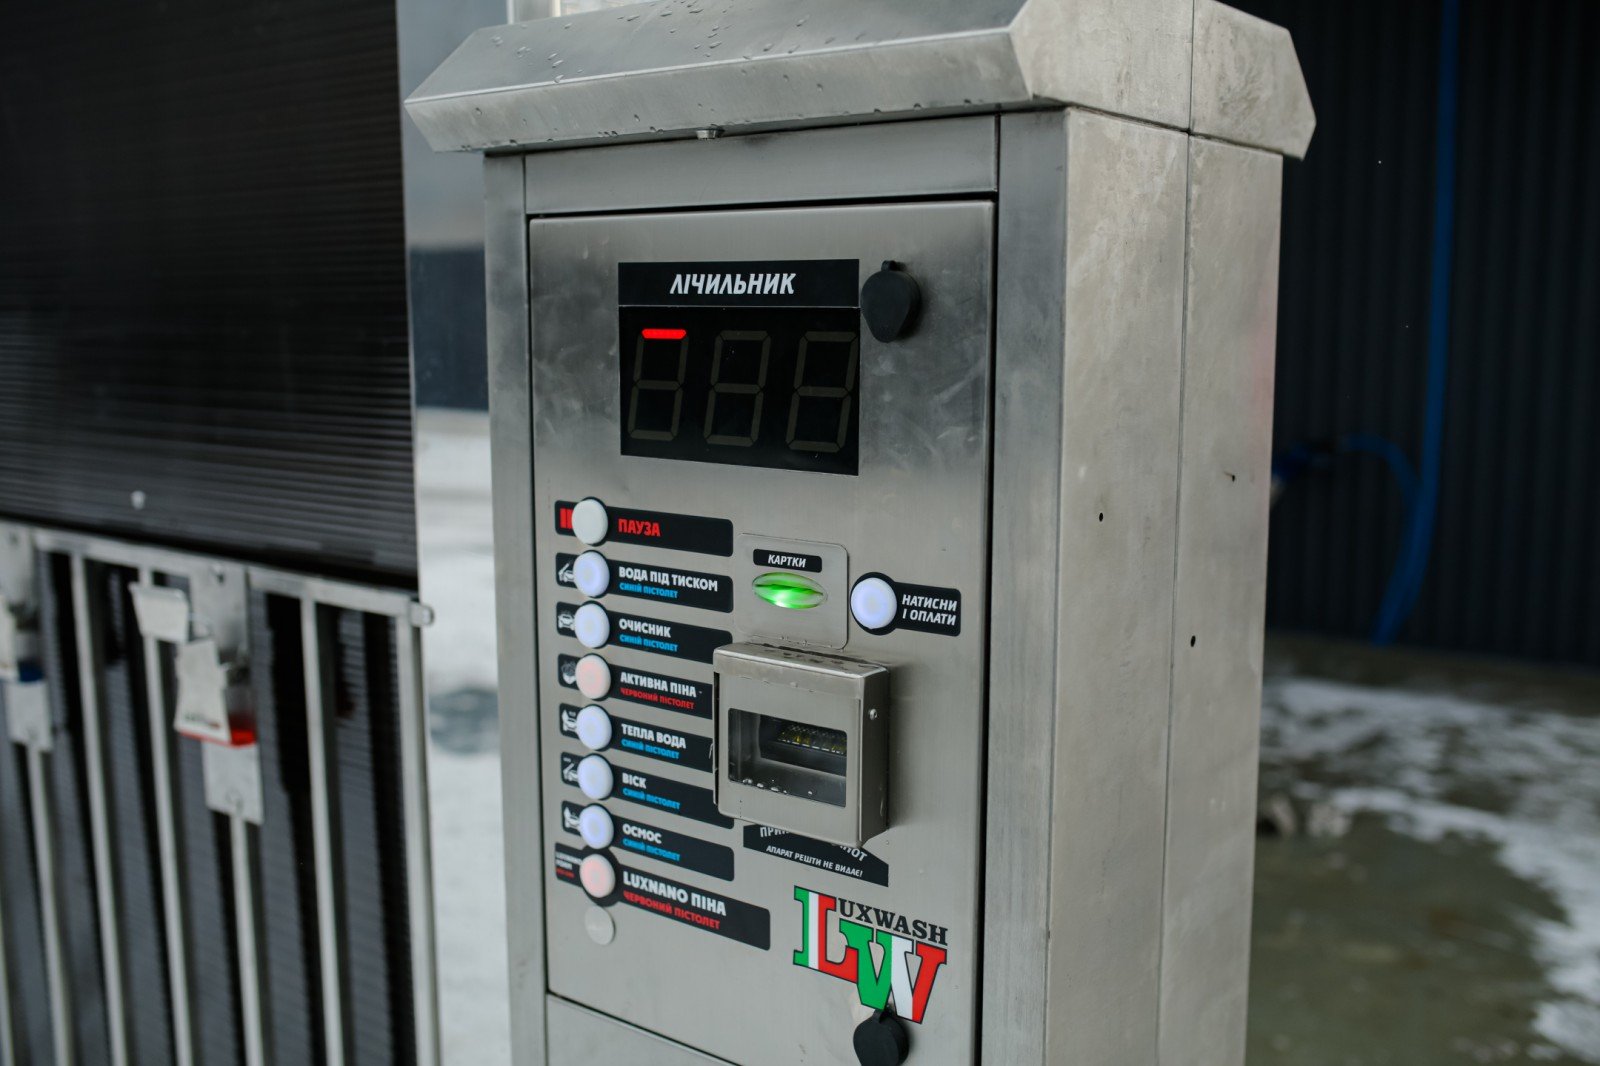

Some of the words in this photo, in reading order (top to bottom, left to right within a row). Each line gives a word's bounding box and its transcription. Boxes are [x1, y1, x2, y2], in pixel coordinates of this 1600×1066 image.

[669, 273, 796, 295] ЛІЧИЛЬНИК
[618, 518, 661, 536] ПАУЗА
[768, 554, 807, 568] КАРТКИ
[618, 566, 648, 581] ВОДА
[649, 570, 670, 585] ПІД
[672, 575, 717, 591] ТИСКОМ
[619, 582, 642, 593] СИНІЙ
[644, 586, 678, 598] ПІСТОЛЕТ
[901, 594, 958, 612] НАТИСНИ
[910, 610, 956, 626] ОПЛАТИ
[619, 618, 671, 637] ОЧИСНИК
[619, 634, 642, 645] СИНІЙ
[643, 639, 678, 652] ПІСТОЛЕТ
[620, 672, 667, 692] АКТИВНА
[670, 682, 697, 697] ПІНА
[620, 688, 657, 702] ЧЕРВОНИЙ
[659, 695, 694, 709] ПІСТОЛЕТ
[621, 723, 654, 741] ТЕПЛА
[656, 731, 686, 748] ВОДА
[644, 745, 679, 759] ПІСТОЛЕТ
[622, 772, 647, 788] ВІСК
[646, 795, 681, 809] ПІСТОЛЕТ
[622, 823, 661, 843] ОСМОС
[646, 845, 681, 861] ПІСТОЛЕТ
[766, 845, 794, 857] АПАРАТ
[794, 852, 822, 865] РЕШТИ
[823, 860, 834, 869] НЕ
[835, 863, 864, 877] ВИДАЄ!
[623, 871, 687, 903] LUXNANO
[691, 892, 726, 916] ПІНА
[623, 890, 671, 915] ЧЕРВОНИЙ
[674, 907, 720, 929] ПІСТОЛЕТ
